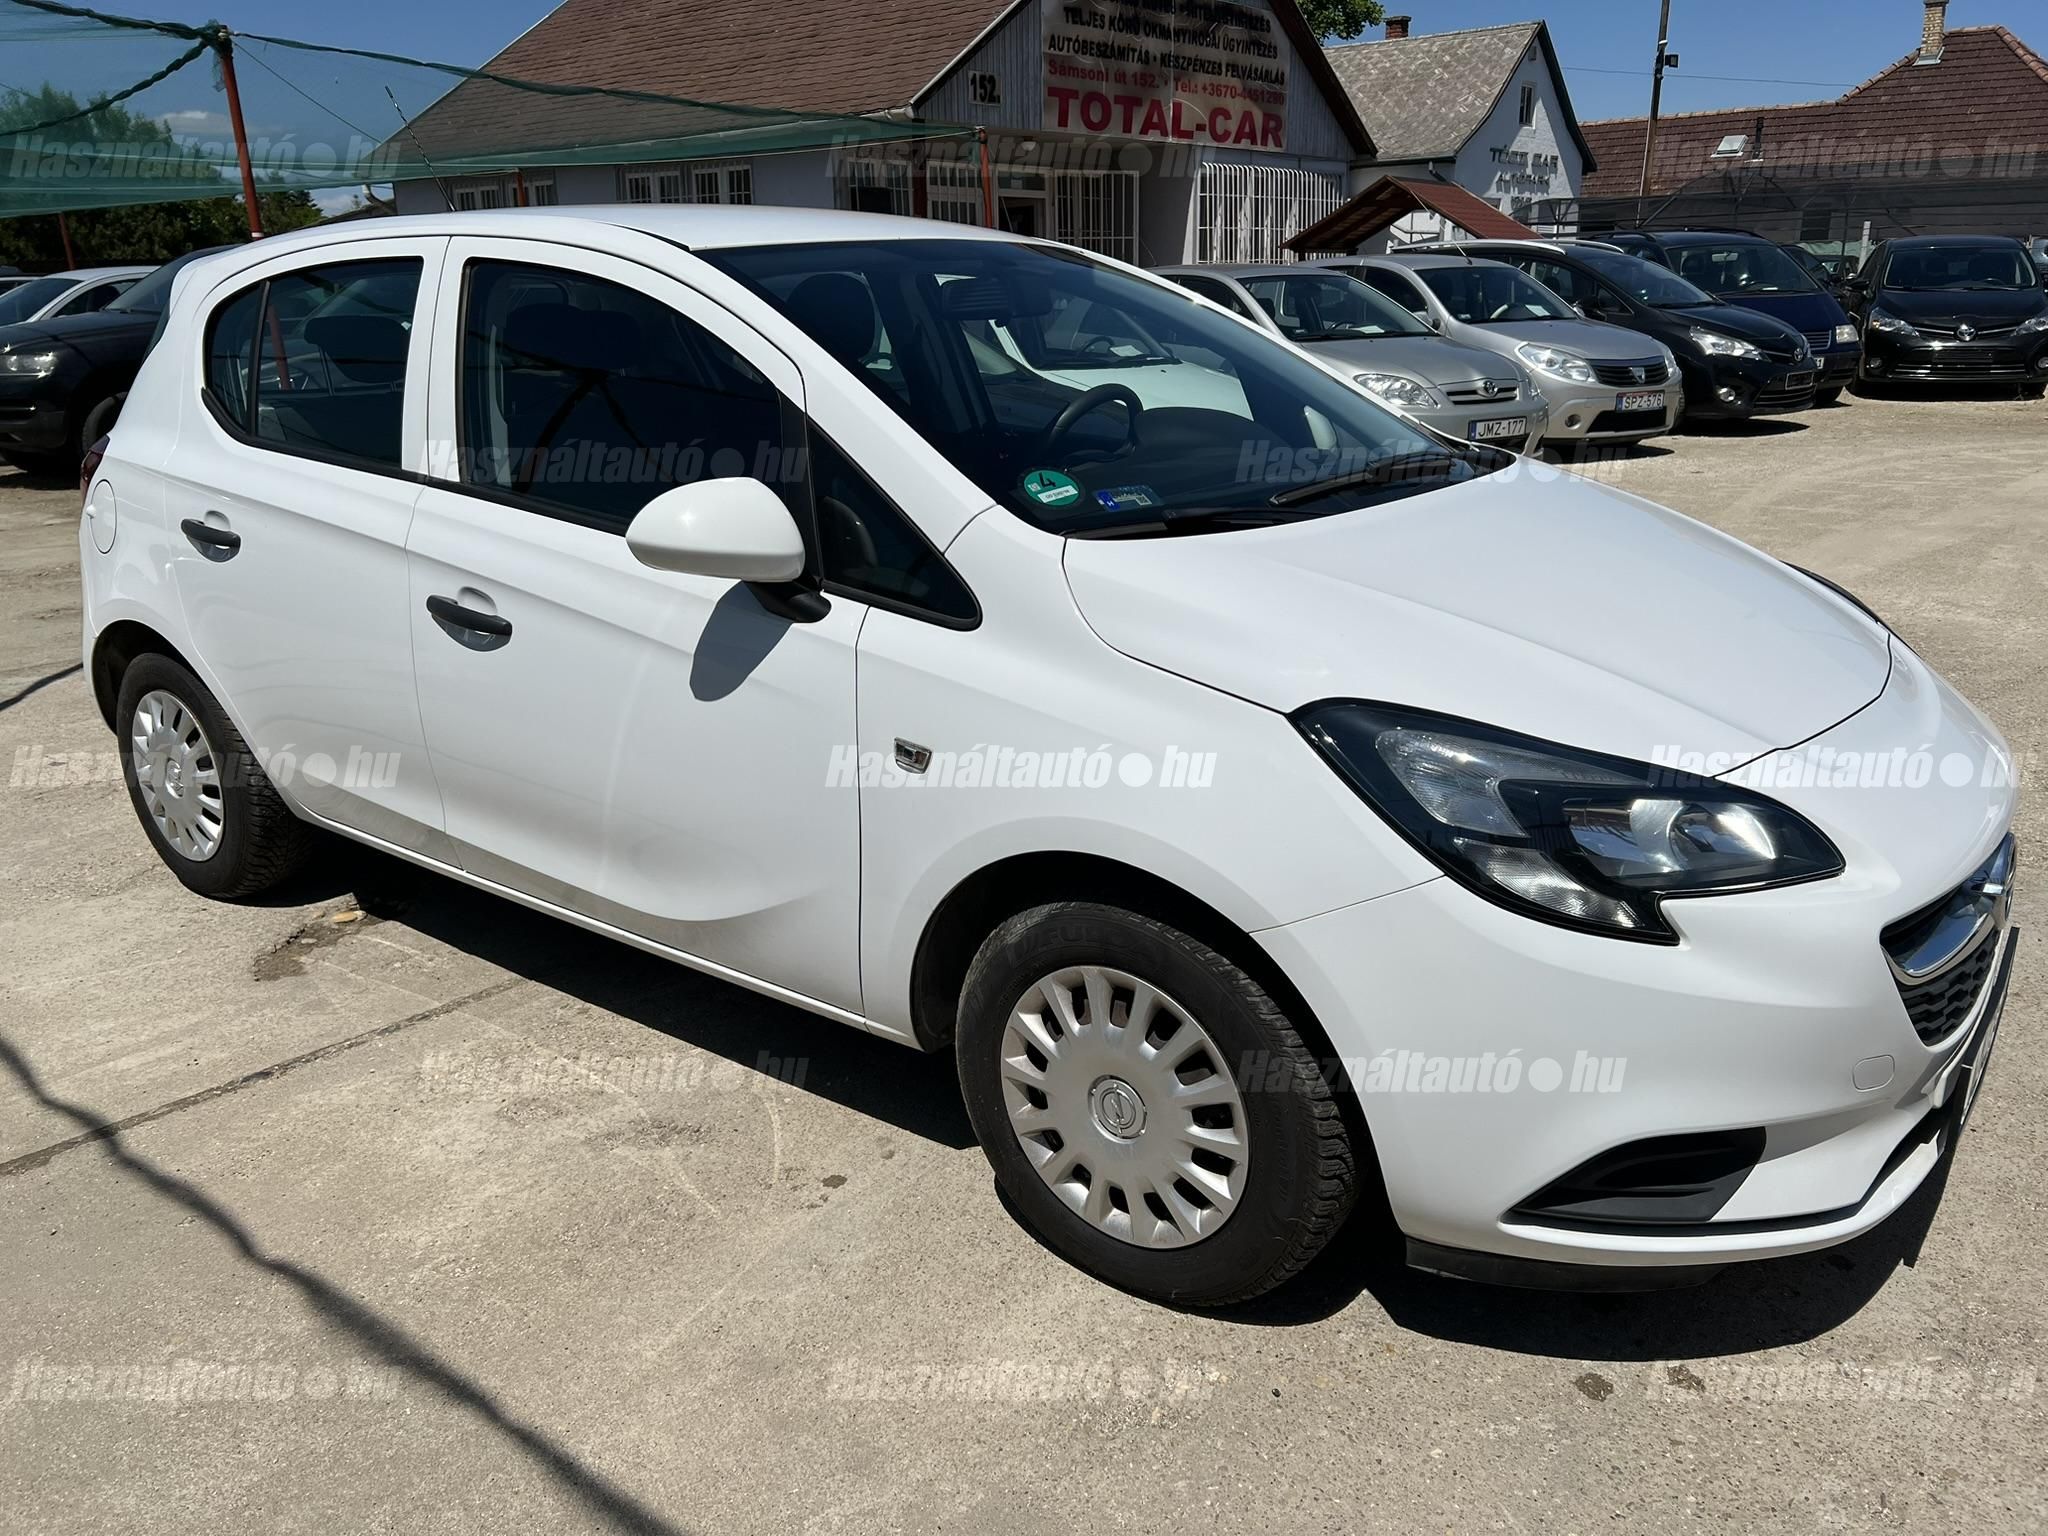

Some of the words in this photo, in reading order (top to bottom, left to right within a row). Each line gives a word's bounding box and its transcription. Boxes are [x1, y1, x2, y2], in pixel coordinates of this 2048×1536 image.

[1063, 7, 1105, 31] TELJES
[1048, 34, 1150, 65] AUTÓBESZÁMÍTÁS
[1160, 51, 1223, 76] KÉSZPÉNZES
[1225, 63, 1285, 86] FELVÁSÁRLÁS
[1048, 59, 1109, 82] Sámsoni
[1114, 70, 1127, 86] út
[970, 72, 1000, 104] 152.
[1047, 87, 1284, 148] TOTAL-CAR
[1624, 393, 1662, 410] SPZ-576
[1478, 418, 1524, 438] JMZ-177
